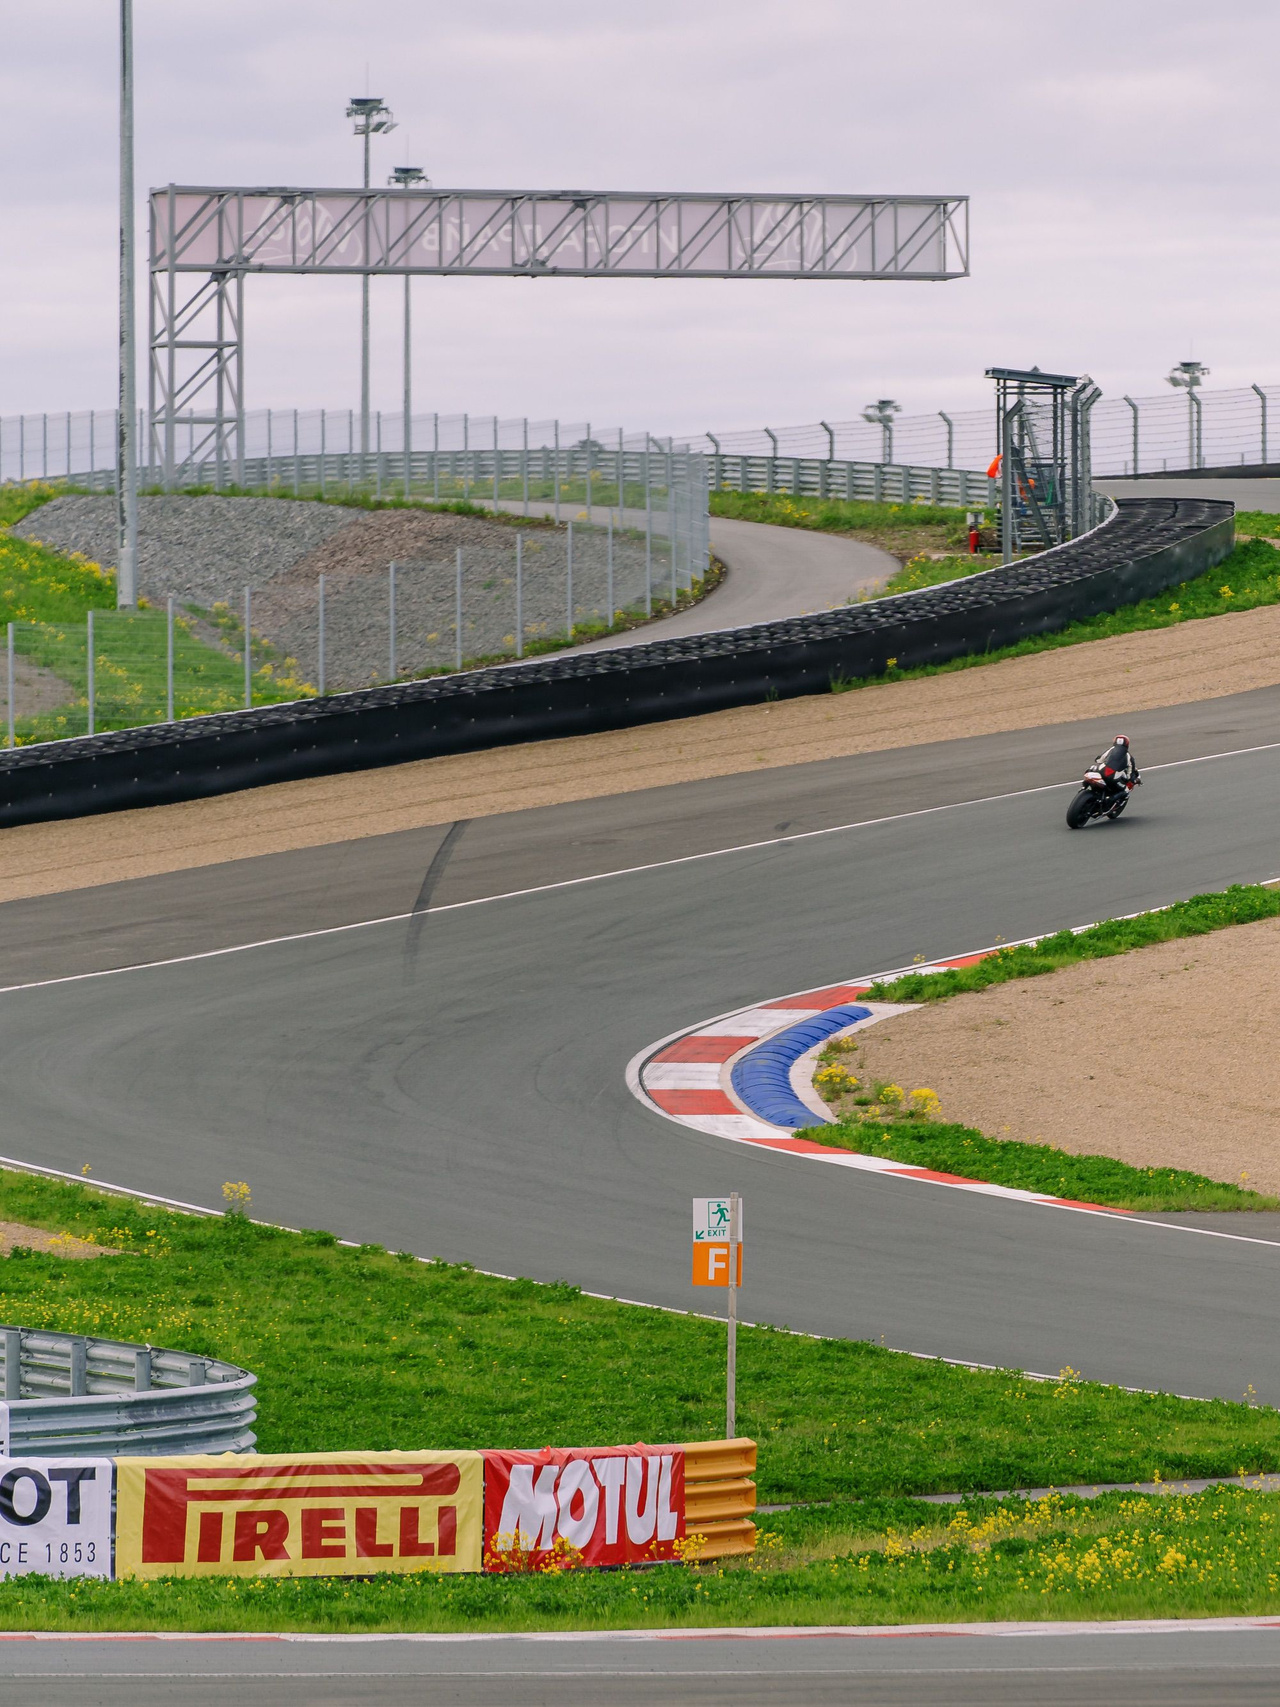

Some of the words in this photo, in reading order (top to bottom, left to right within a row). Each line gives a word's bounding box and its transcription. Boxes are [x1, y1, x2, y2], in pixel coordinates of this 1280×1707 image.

[708, 1229, 727, 1237] EXIT
[708, 1248, 728, 1280] F
[142, 1462, 461, 1564] PIRELLI
[497, 1455, 678, 1552] MOTUL
[45, 1542, 96, 1563] 1853
